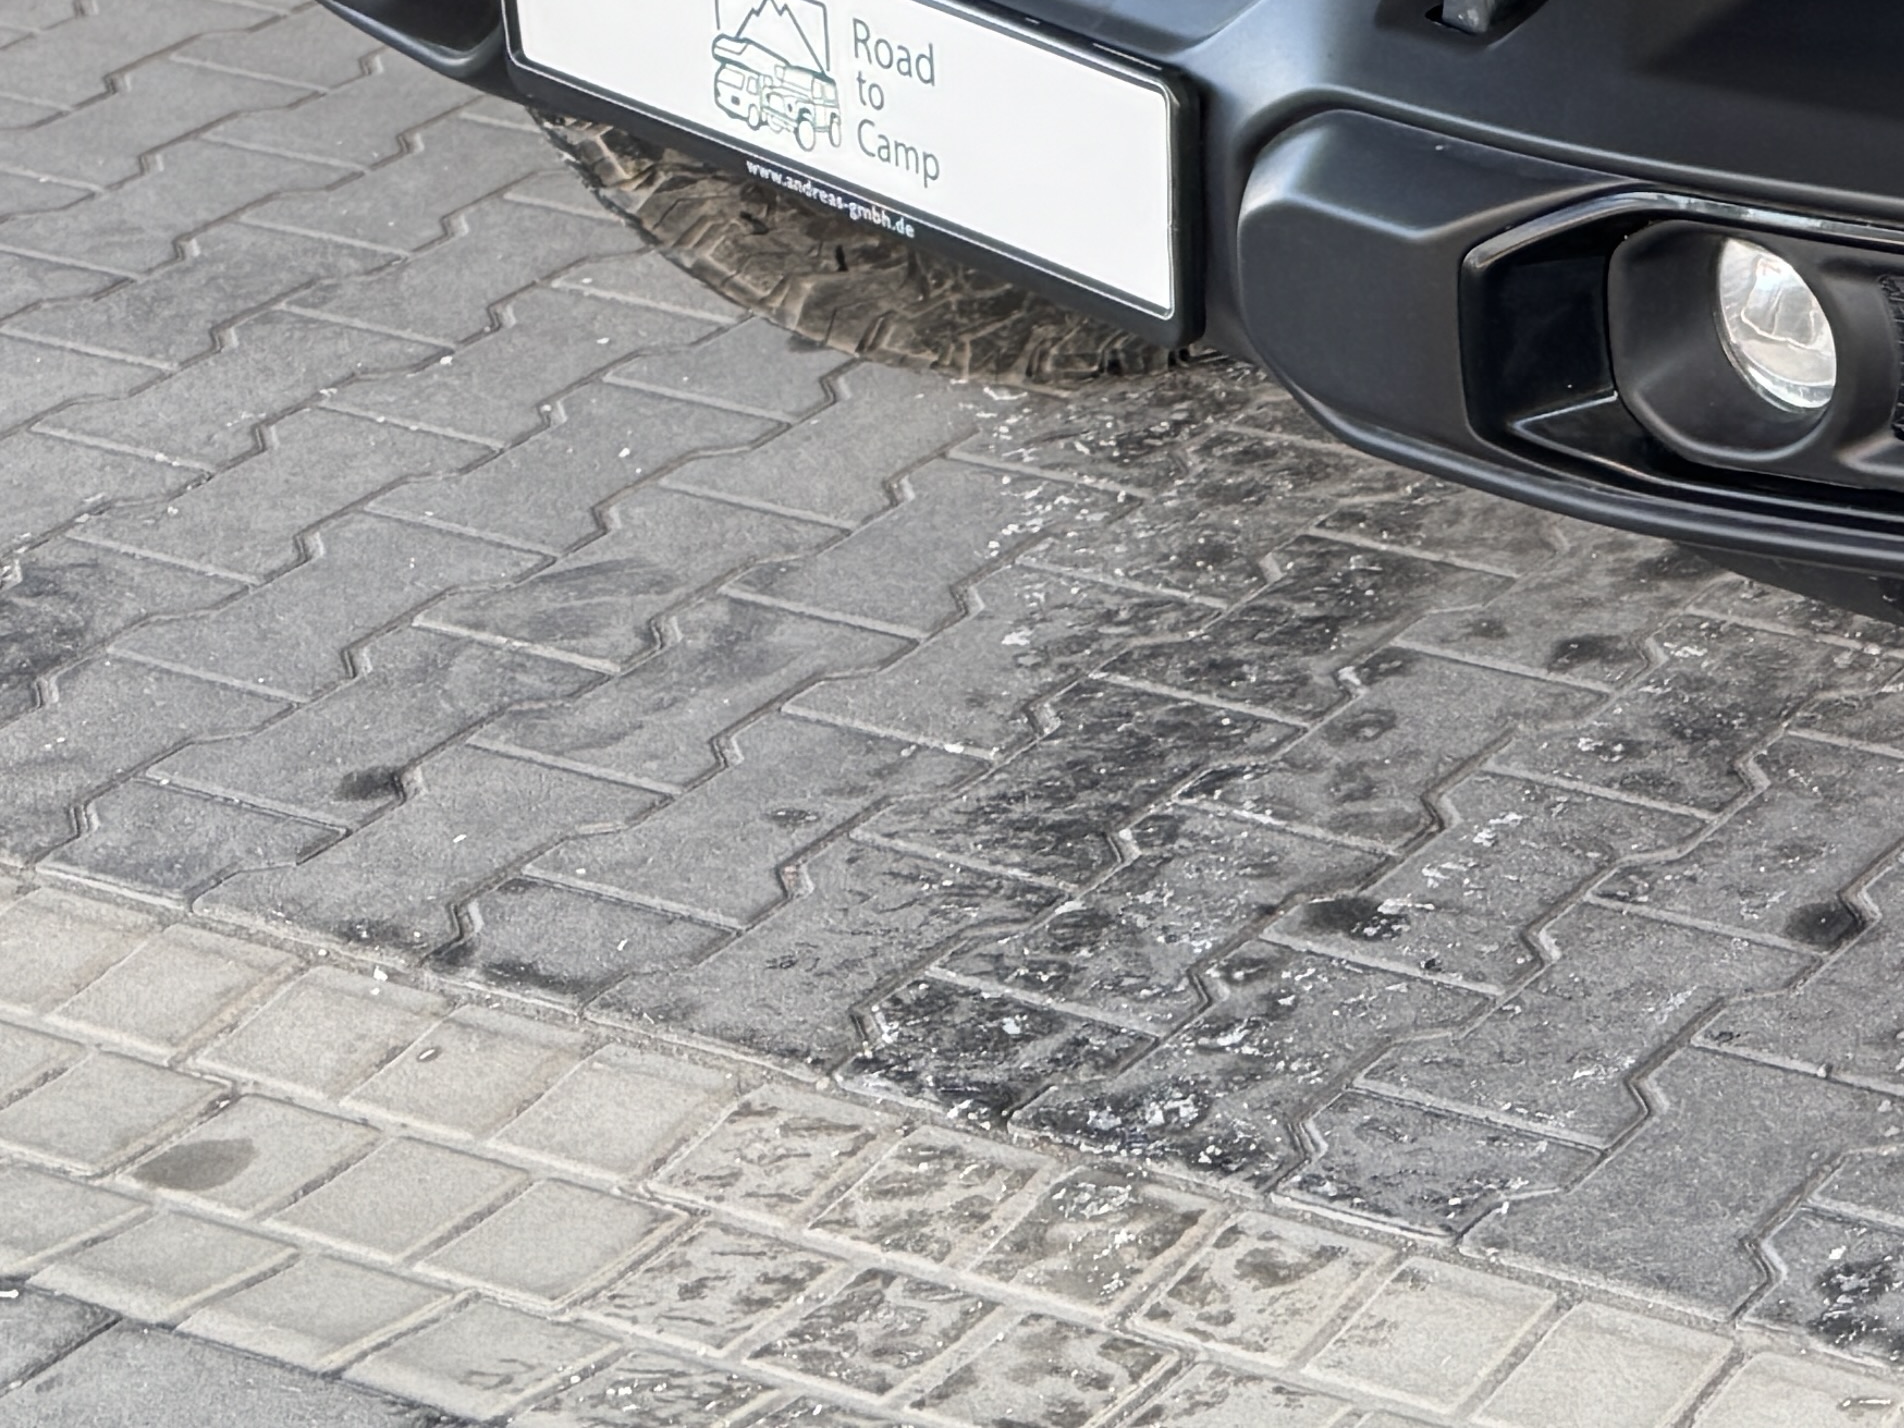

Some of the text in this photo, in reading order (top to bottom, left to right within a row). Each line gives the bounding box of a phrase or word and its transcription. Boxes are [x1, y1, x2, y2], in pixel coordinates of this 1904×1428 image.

[852, 17, 936, 87] Road
[856, 70, 885, 112] to
[856, 118, 941, 189] Camp
[745, 159, 916, 239] www.andreas-gmbh.de
